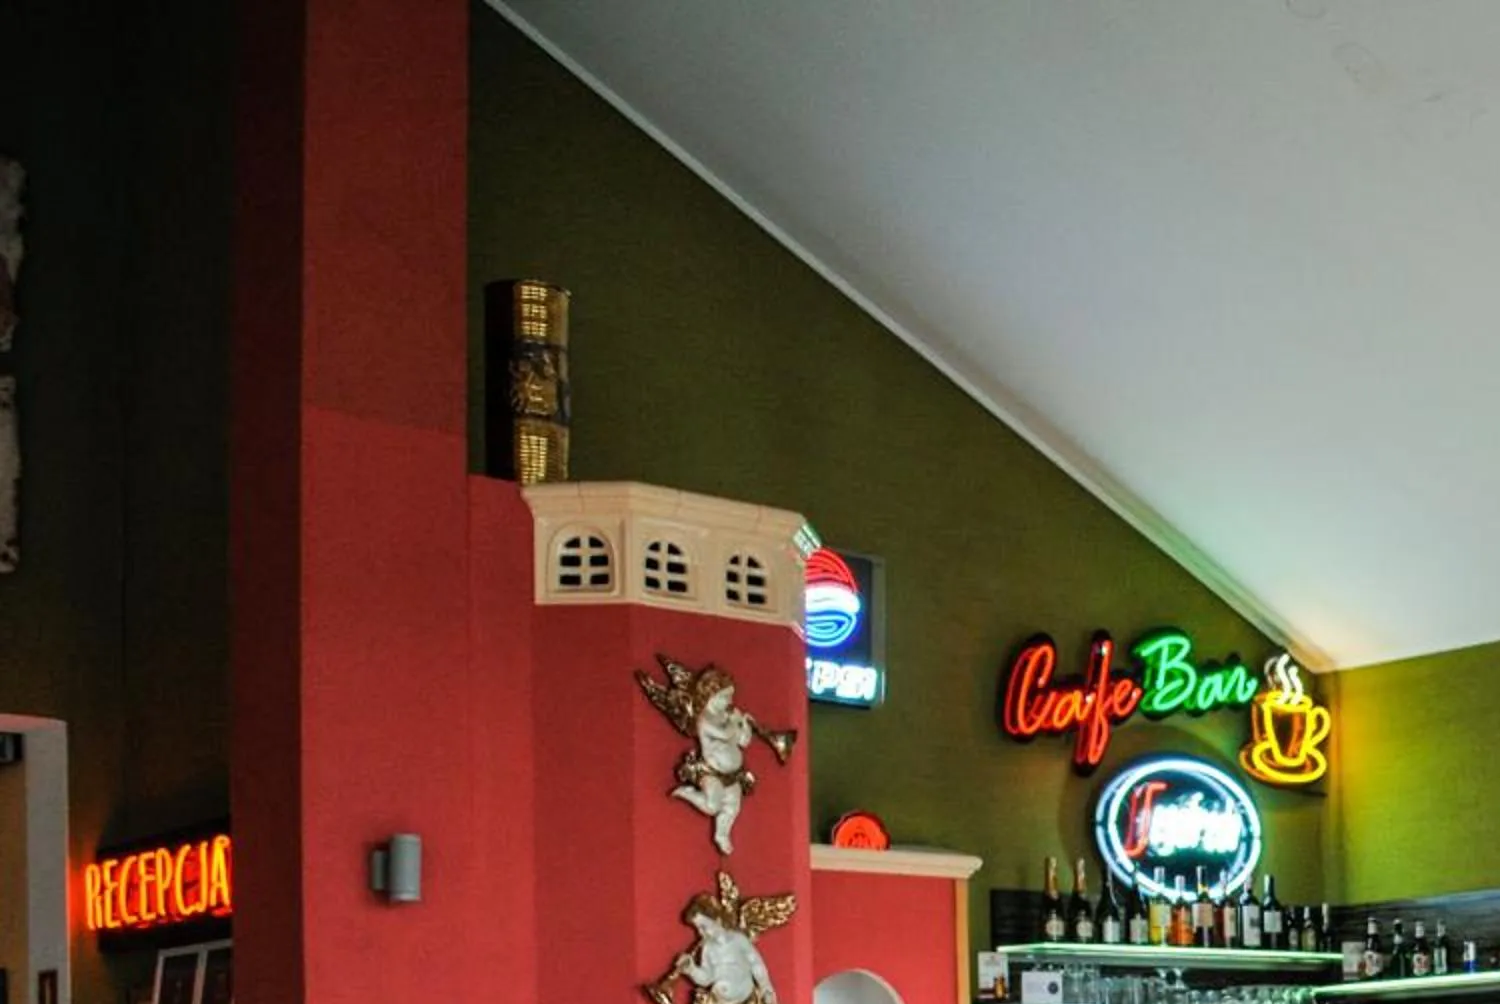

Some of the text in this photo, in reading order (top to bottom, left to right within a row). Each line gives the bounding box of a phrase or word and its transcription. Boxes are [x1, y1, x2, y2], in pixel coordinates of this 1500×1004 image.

[1008, 634, 1258, 764] Cafe Bar
[85, 834, 231, 930] RECEPCJA
